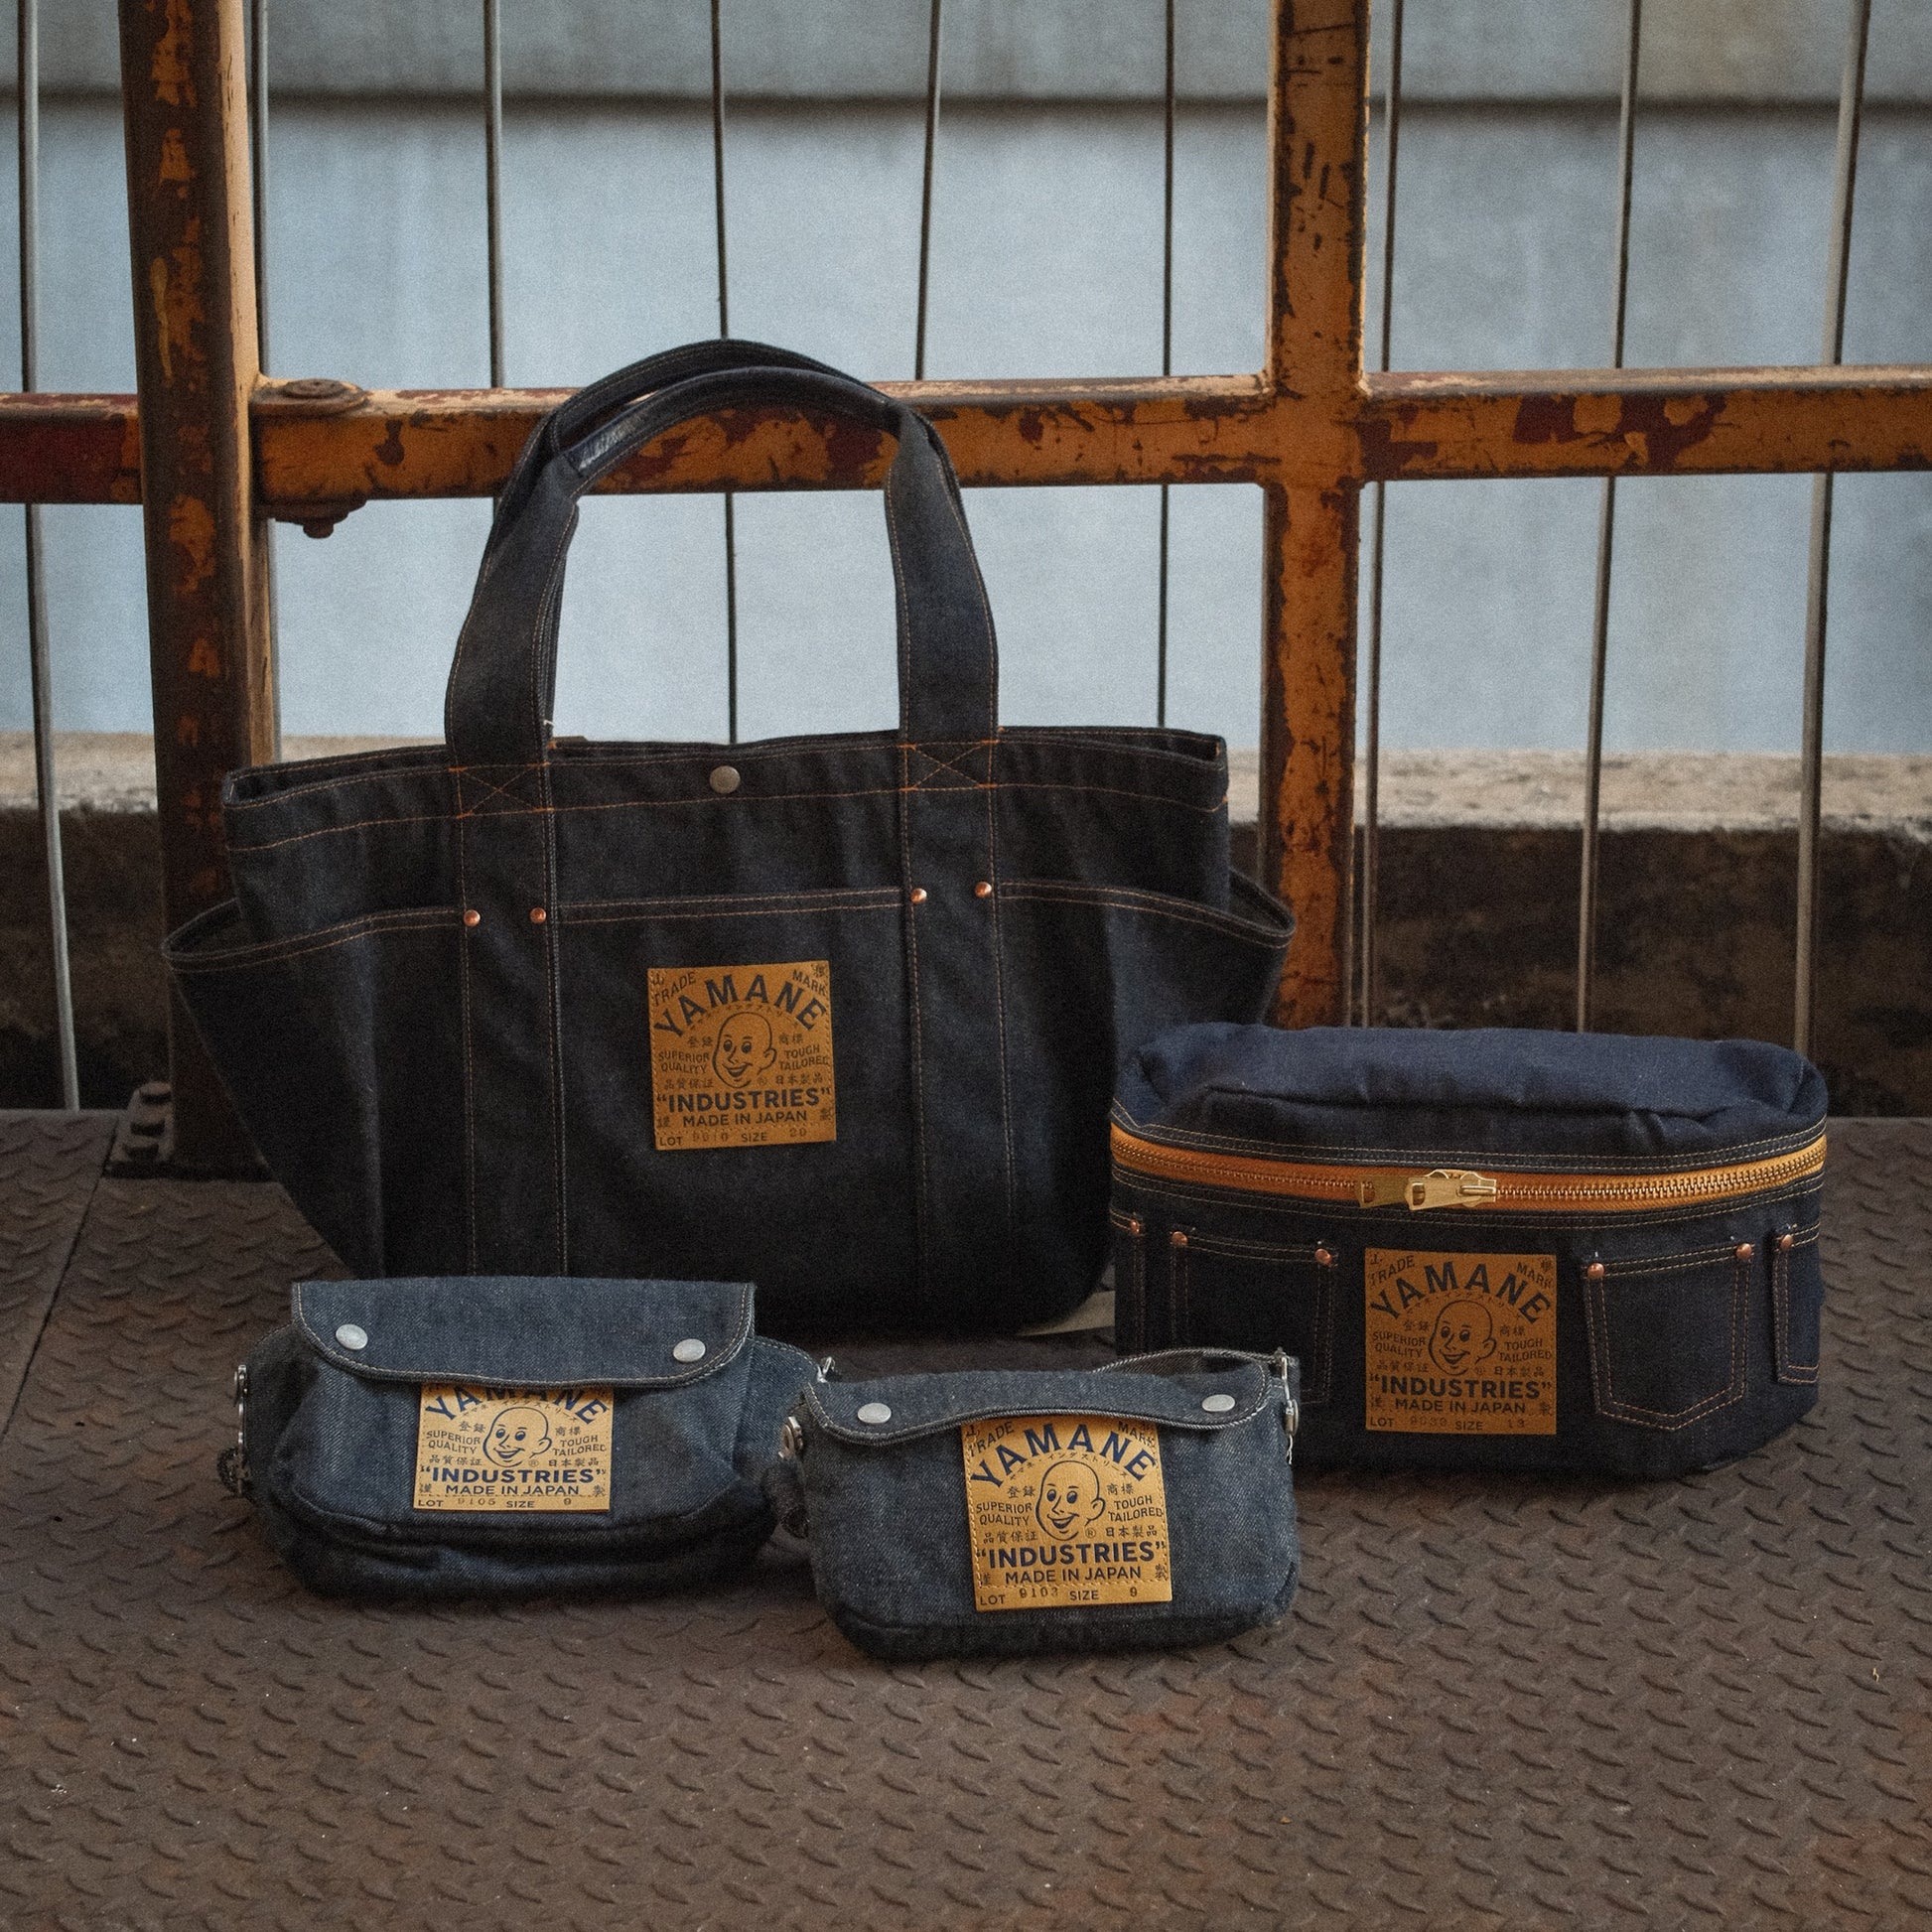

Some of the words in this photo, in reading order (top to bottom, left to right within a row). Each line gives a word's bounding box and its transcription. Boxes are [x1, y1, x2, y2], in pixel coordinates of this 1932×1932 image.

[653, 972, 696, 1006] TRADE
[792, 969, 826, 996] MARK
[653, 974, 827, 1037] YAMANE
[658, 1050, 710, 1061] SUPERIOR
[785, 1044, 820, 1059] TOUGH
[661, 1062, 708, 1073] QUALITY
[683, 1114, 729, 1127] MADE
[735, 1113, 751, 1125] IN
[756, 1110, 807, 1124] JAPAN
[659, 1136, 683, 1147] LOT
[742, 1132, 767, 1143] SIZE
[789, 1128, 806, 1138] 20
[1369, 1255, 1415, 1287] TRADE
[1517, 1262, 1553, 1289] MARK
[1370, 1261, 1551, 1324] YAMANE
[1372, 1331, 1426, 1346] SUPERIOR
[1505, 1338, 1543, 1351] TOUGH
[1375, 1343, 1423, 1358] QUALITY
[1498, 1350, 1552, 1362] TAILORED
[1395, 1399, 1444, 1412] MADE
[1449, 1400, 1466, 1413] IN
[1471, 1402, 1526, 1414] JAPAN
[459, 1422, 486, 1434] 登録
[555, 1427, 581, 1437] 商標
[1370, 1418, 1395, 1428] LOT
[1455, 1421, 1483, 1431] SIZE
[426, 1431, 481, 1445] SUPERIOR
[561, 1436, 598, 1448] TOUGH
[968, 1422, 1015, 1457] TRADE
[1118, 1421, 1156, 1447] MARK
[428, 1441, 478, 1454] QUALITY
[429, 1454, 483, 1466] 品質保証
[971, 1423, 1156, 1487] YAMANE
[548, 1458, 600, 1467] 日本製品
[446, 1485, 496, 1495] MADE
[501, 1485, 518, 1494] IN
[523, 1485, 579, 1495] JAPAN
[1008, 1485, 1035, 1498] 登録
[1107, 1484, 1135, 1495] 商標
[976, 1502, 1032, 1514] SUPERIOR
[1114, 1496, 1153, 1509] TOUGH
[980, 1514, 1030, 1526] QUALITY
[1108, 1508, 1164, 1522] TAILORED
[983, 1532, 1037, 1544] 品質保証
[1105, 1525, 1158, 1538] 日本製品
[1006, 1570, 1055, 1584] MADE
[1062, 1568, 1079, 1581] IN
[1085, 1567, 1141, 1581] JAPAN
[980, 1594, 1005, 1605] LOT
[1069, 1590, 1099, 1600] SIZE
[1130, 1587, 1138, 1597] 9
